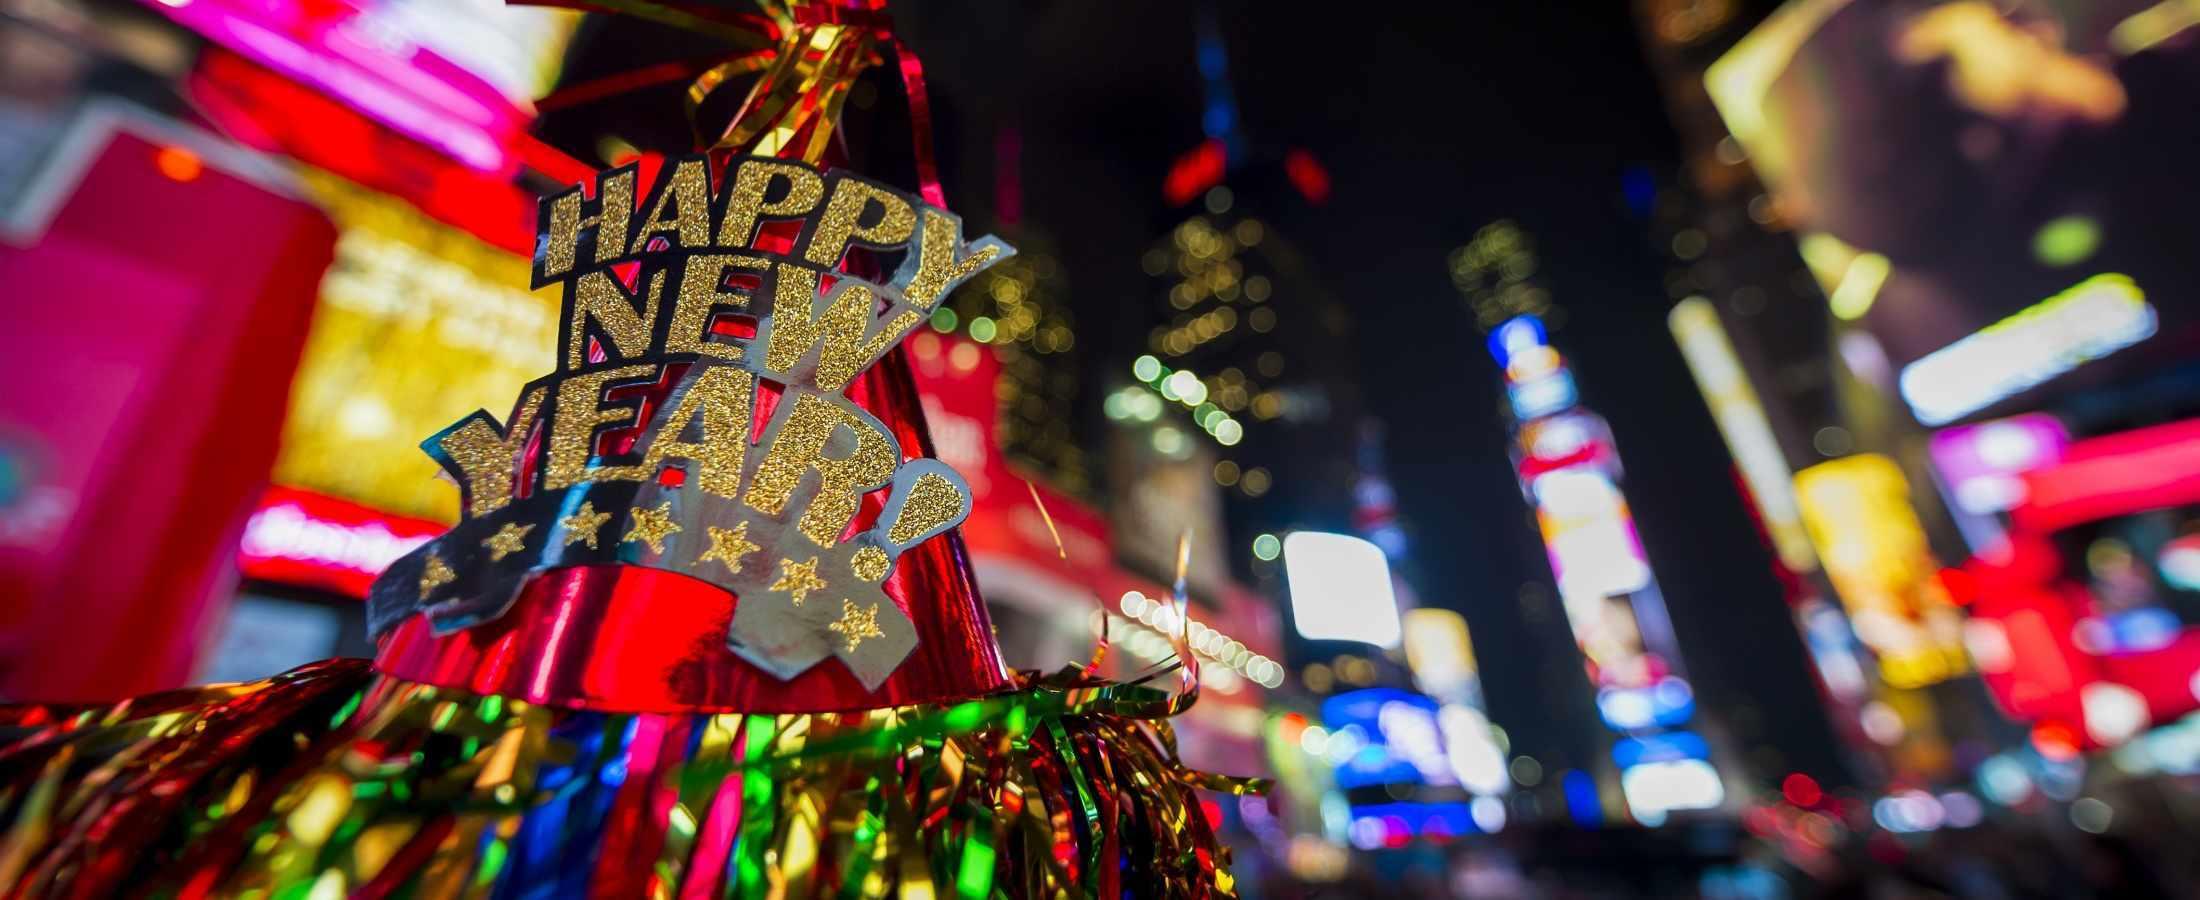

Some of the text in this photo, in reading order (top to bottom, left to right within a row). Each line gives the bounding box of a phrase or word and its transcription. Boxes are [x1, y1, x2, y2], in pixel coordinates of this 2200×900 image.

[544, 159, 999, 306] HAPPY
[568, 254, 921, 391] NEW
[441, 364, 966, 582] YEAR!
